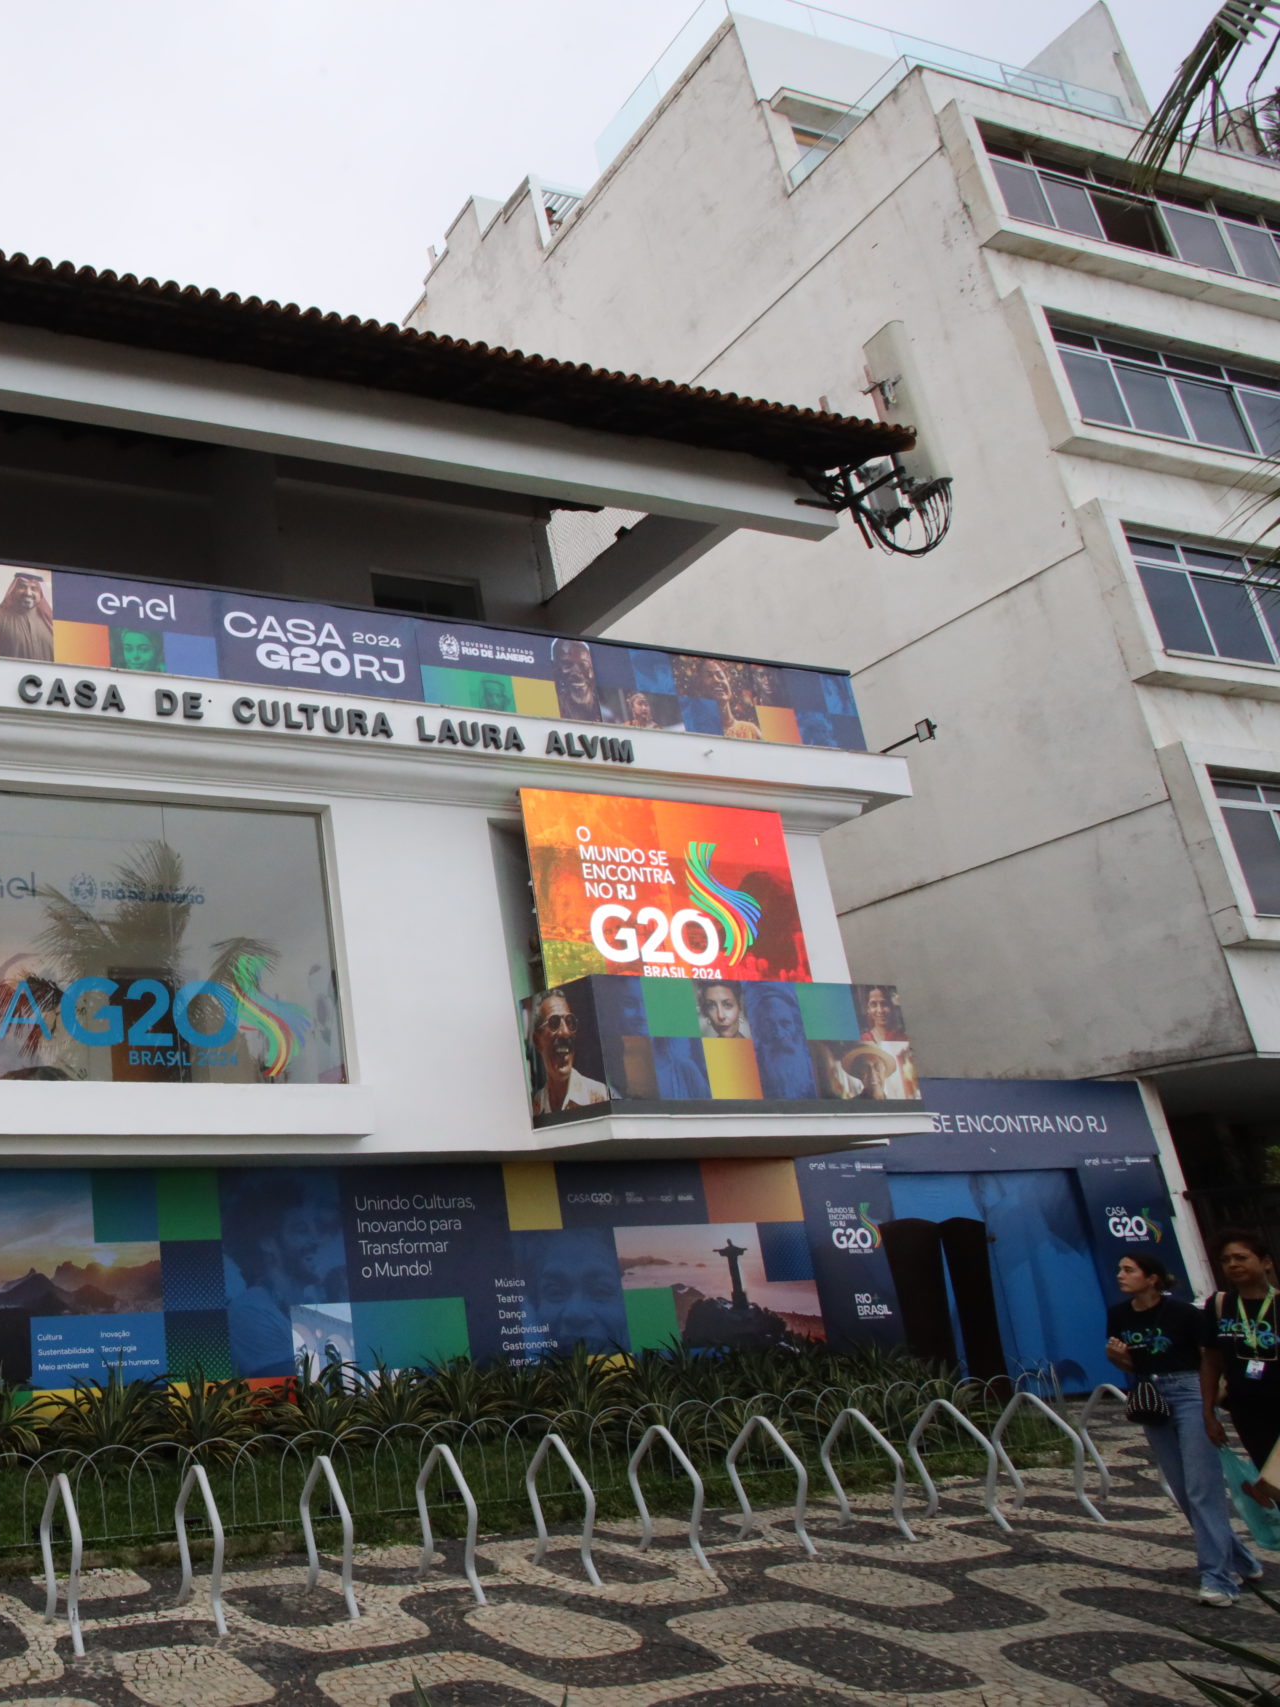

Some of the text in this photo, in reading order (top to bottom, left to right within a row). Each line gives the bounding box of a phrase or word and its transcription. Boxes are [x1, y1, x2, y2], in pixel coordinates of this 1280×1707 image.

[97, 592, 176, 621] enel
[223, 611, 402, 650] CASA 2024
[461, 640, 493, 650] GOVERNO
[508, 648, 534, 656] ESTADO
[461, 647, 535, 664] RIO DE JANEIRO
[18, 674, 634, 764] CASA DE CULTURA LAURA ALVIM
[576, 826, 591, 842] O
[578, 844, 669, 867] MUNDO SE
[582, 863, 676, 885] ENCONTRA
[585, 881, 637, 900] NO RJ
[590, 904, 719, 966] G20
[643, 965, 722, 979] BRASIL 2024
[129, 1051, 239, 1068] BRASIL 2024
[931, 1114, 1108, 1133] SE ENCONTRA NO RJ
[355, 1193, 475, 1211] Unindo Culturas,
[1105, 1206, 1128, 1217] CASA
[357, 1216, 462, 1236] Inovando para
[1108, 1215, 1147, 1238] G20
[832, 1227, 872, 1249] G20
[358, 1238, 449, 1256] Transformar
[361, 1260, 433, 1279] o Mundo!
[494, 1278, 526, 1288] Música
[496, 1294, 524, 1303] Teatro
[854, 1293, 872, 1304] RIO
[498, 1310, 527, 1320] Dança
[856, 1304, 893, 1316] BRASIL
[100, 1330, 130, 1338] Inovação
[500, 1323, 550, 1335] Audiovisual
[37, 1333, 63, 1342] Cultura
[502, 1338, 558, 1350] Gastronomia
[38, 1347, 95, 1356] Sustentabilidade
[38, 1361, 89, 1370] Meio ambiente
[128, 1359, 160, 1367] humanos
